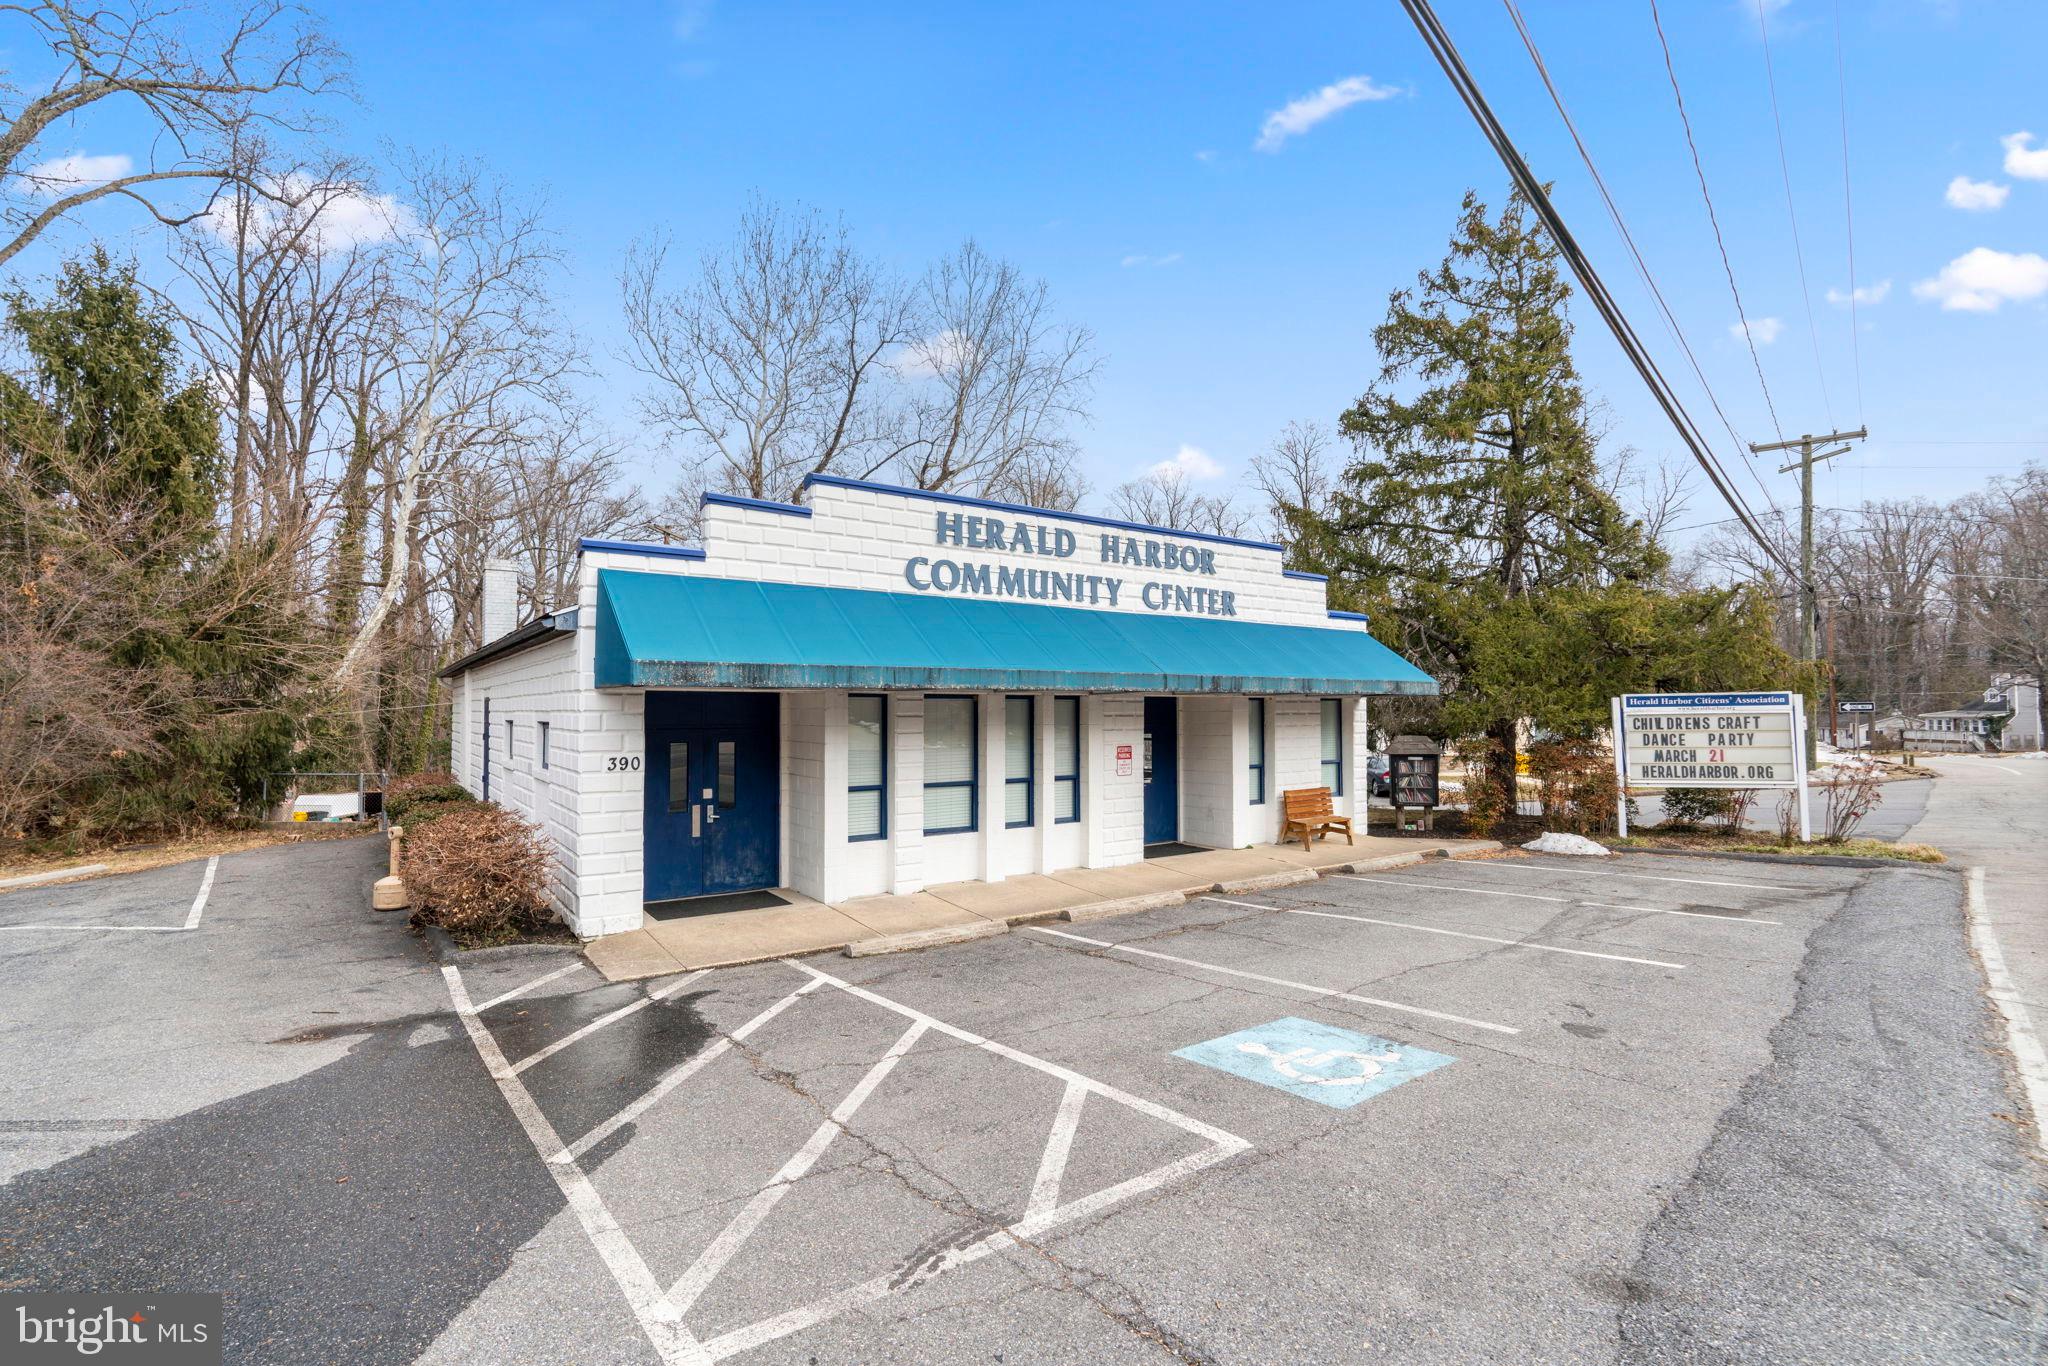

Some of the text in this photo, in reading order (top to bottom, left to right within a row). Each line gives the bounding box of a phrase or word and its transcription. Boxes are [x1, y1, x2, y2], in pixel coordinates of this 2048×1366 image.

[936, 511, 1217, 575] HERALD HARBOR
[905, 556, 1123, 607] COMMUNITY
[1661, 697, 1693, 705] Harbor
[1735, 696, 1785, 704] Association
[1633, 716, 1760, 730] CHILDRENS CRAFT
[1642, 733, 1754, 746] DANCE PARTY
[1654, 749, 1725, 762] MARCH 21
[607, 756, 640, 771] 390
[1642, 765, 1774, 779] HERALDHARBOR.ORG
